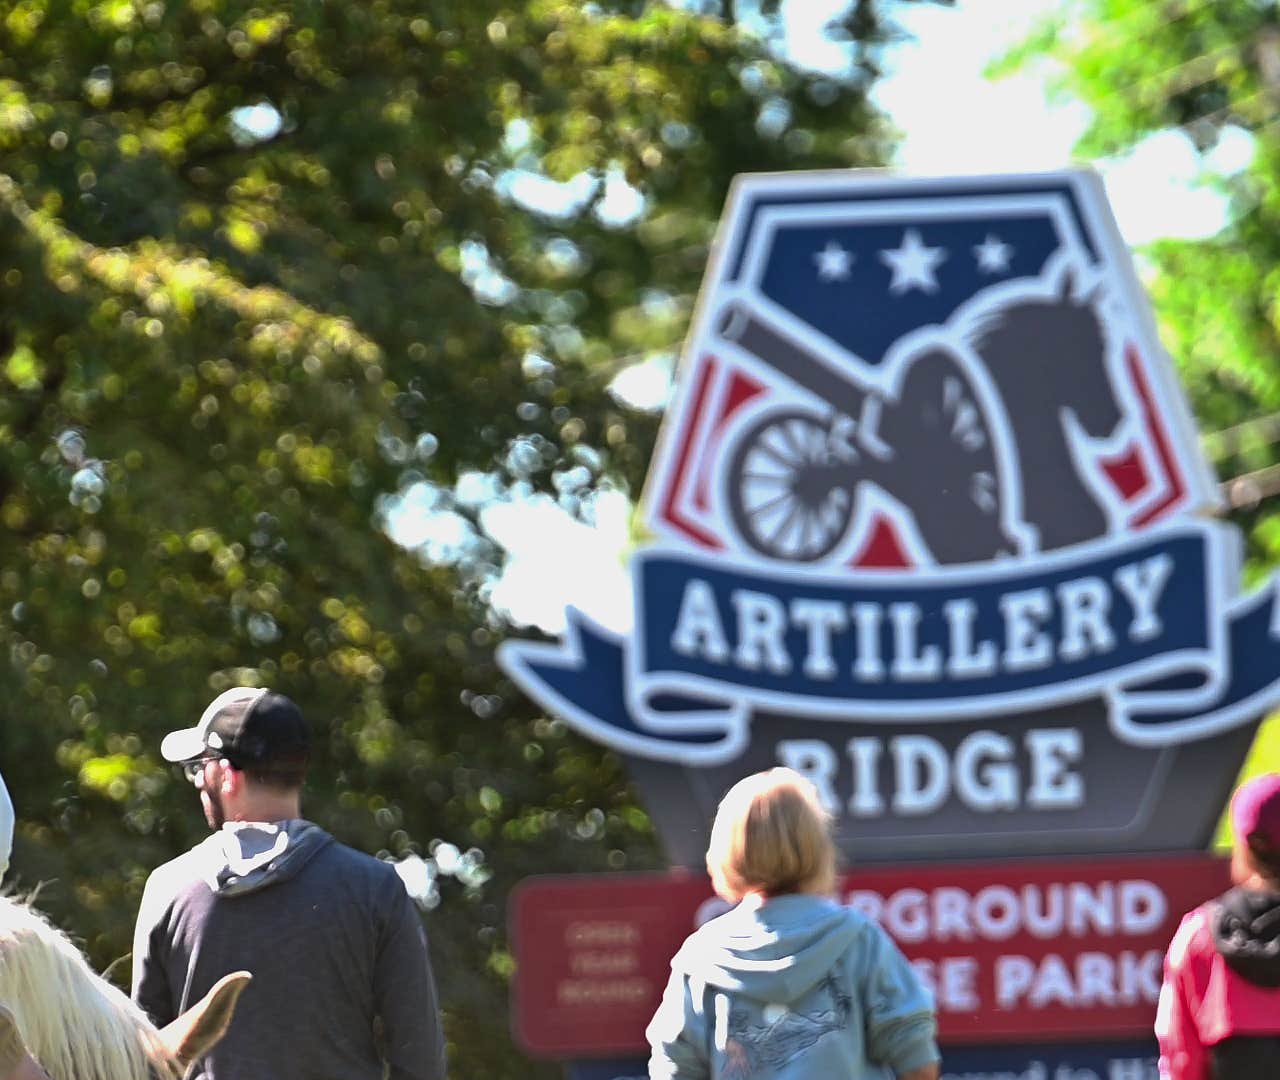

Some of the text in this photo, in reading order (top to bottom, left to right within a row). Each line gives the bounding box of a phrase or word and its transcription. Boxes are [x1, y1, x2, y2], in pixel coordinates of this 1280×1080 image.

[670, 557, 1174, 681] ARTILLERY
[775, 728, 1085, 817] RIDGE
[994, 949, 1166, 1010] PARK
